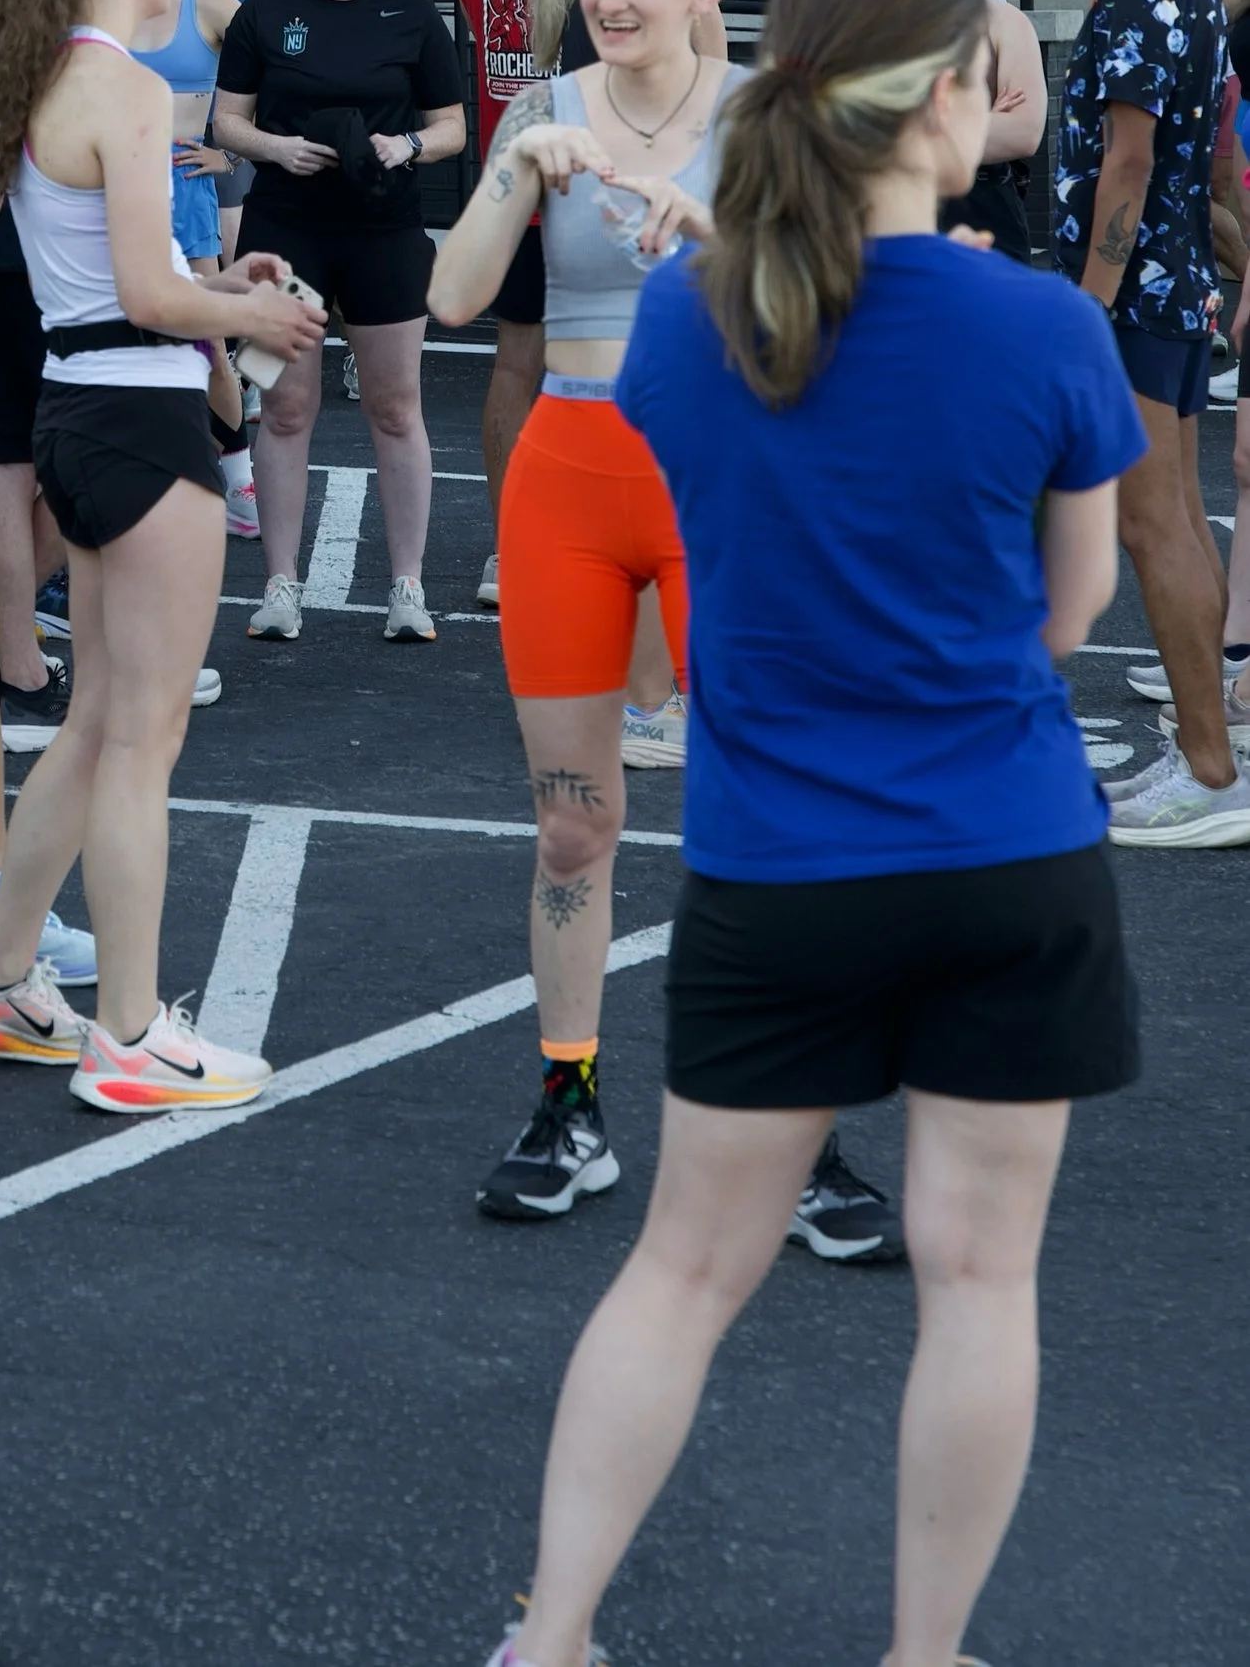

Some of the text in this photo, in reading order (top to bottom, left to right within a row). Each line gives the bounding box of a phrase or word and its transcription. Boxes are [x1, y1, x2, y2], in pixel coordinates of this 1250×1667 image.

[287, 33, 303, 50] NY
[489, 51, 562, 79] ROCHE
[623, 721, 664, 742] HOKA
